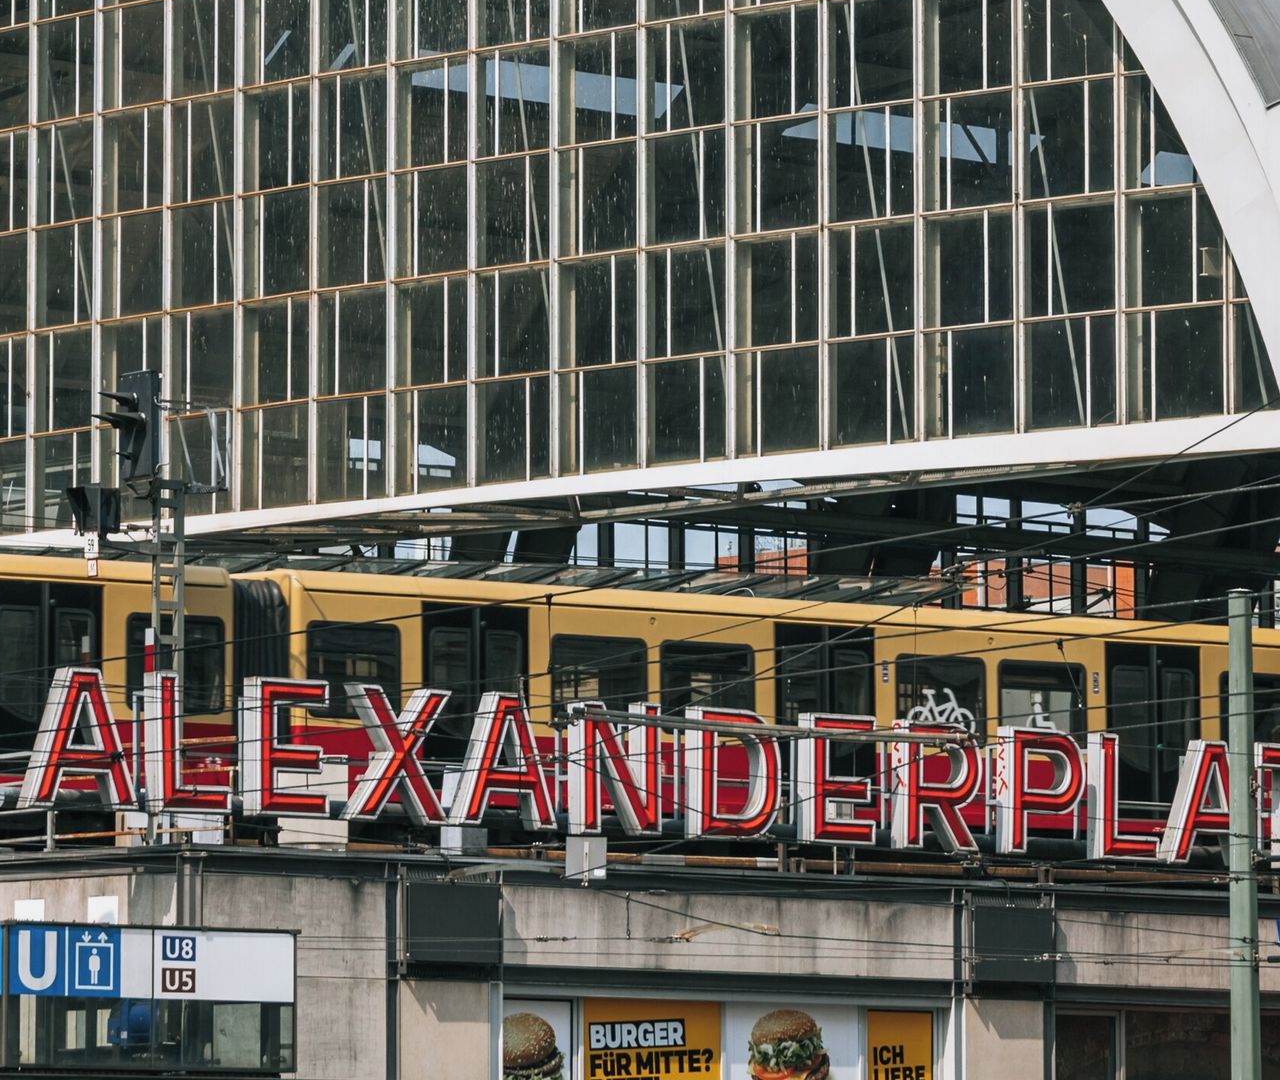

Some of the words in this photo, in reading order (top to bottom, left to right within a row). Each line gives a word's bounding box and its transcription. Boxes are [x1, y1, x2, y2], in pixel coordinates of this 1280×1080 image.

[17, 930, 57, 991] U
[166, 938, 193, 959] U8
[166, 970, 193, 991] U5
[590, 1021, 684, 1049] BURGER
[635, 1048, 713, 1075] MITTE?
[873, 1045, 904, 1066] ICH
